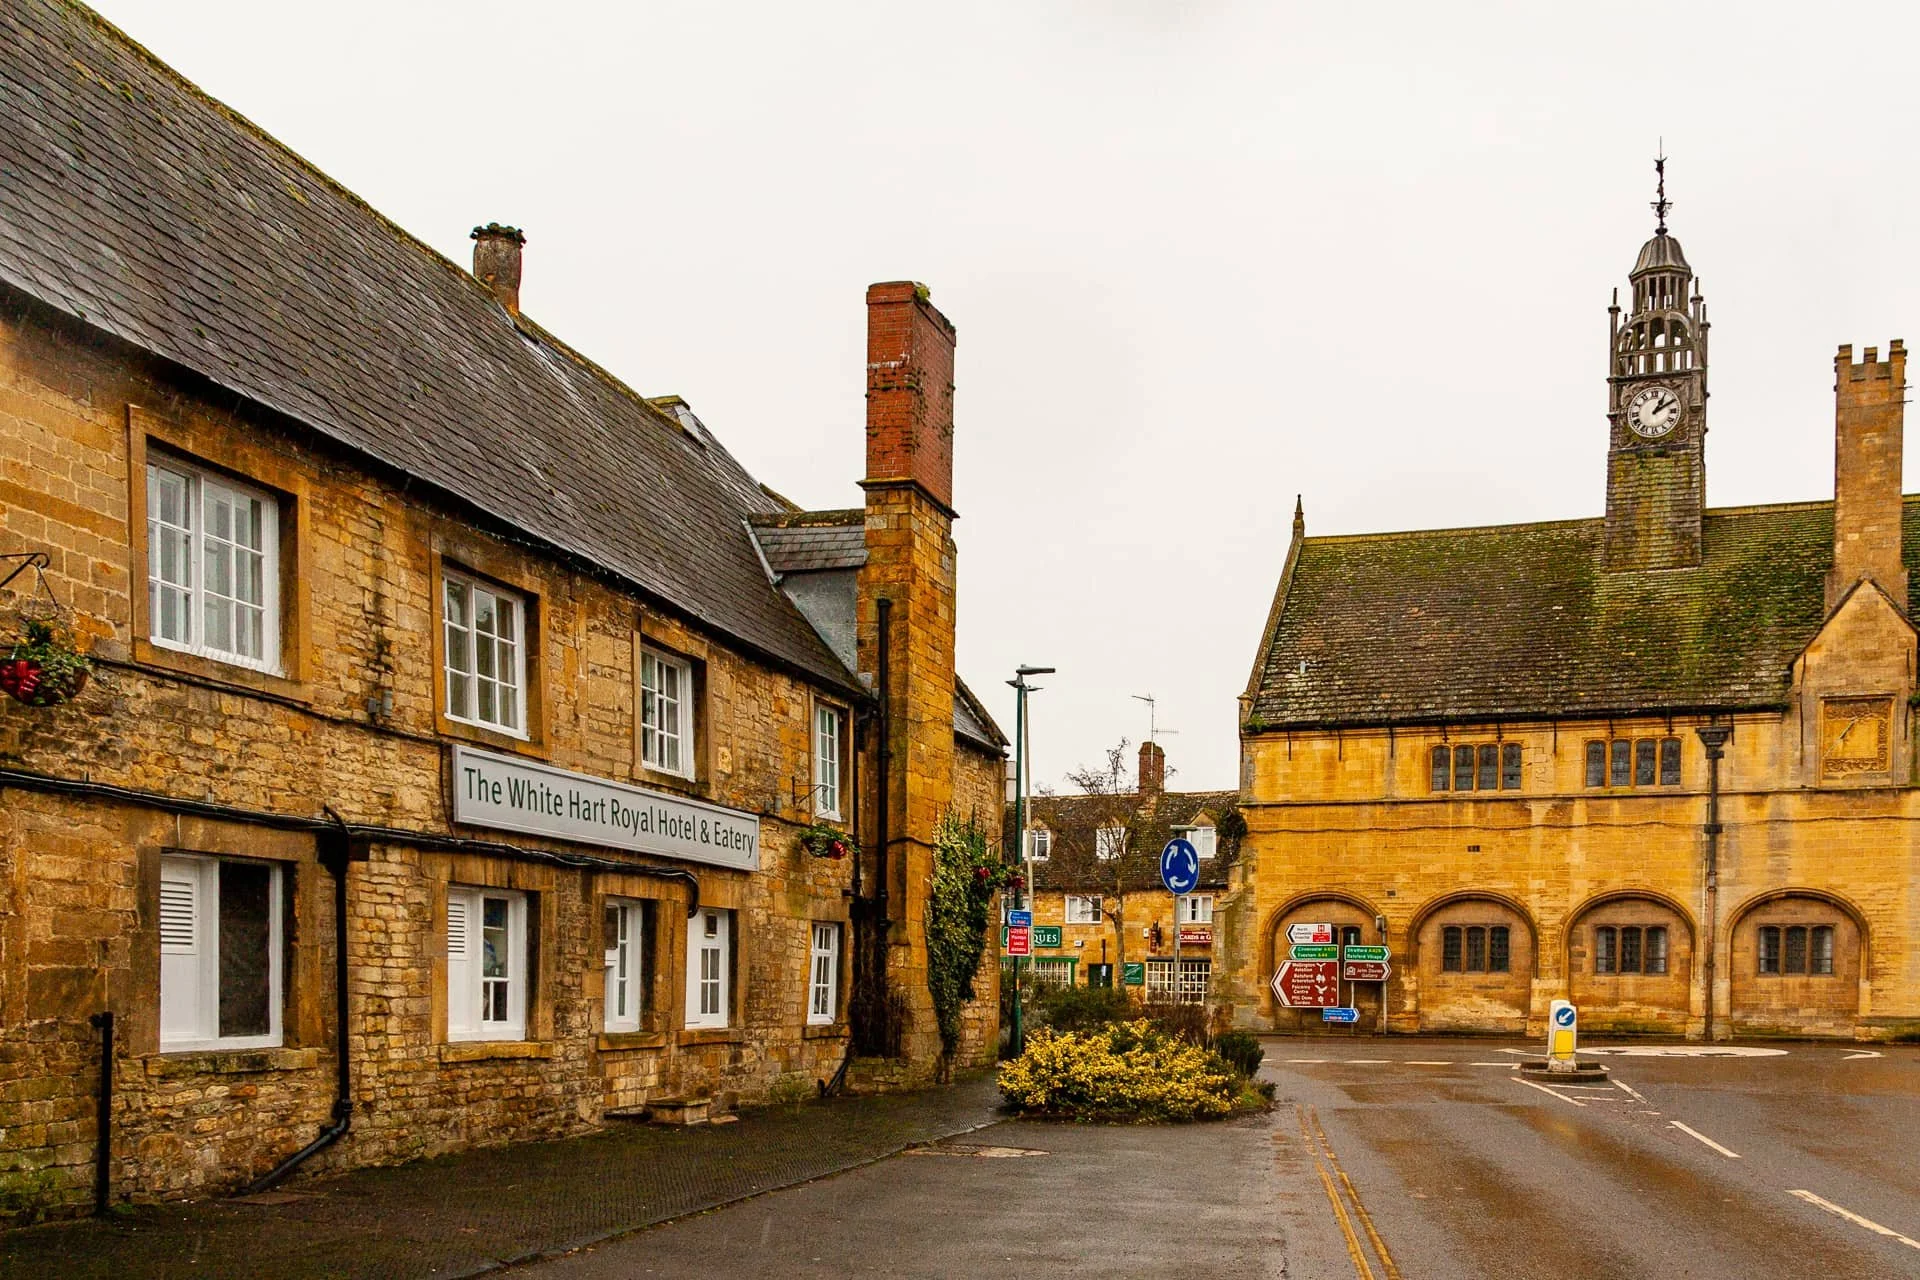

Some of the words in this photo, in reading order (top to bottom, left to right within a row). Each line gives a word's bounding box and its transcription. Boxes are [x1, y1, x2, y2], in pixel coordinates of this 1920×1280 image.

[464, 767, 502, 805] The
[507, 777, 563, 817] White
[569, 789, 606, 825] Hart
[611, 798, 655, 837] Royal
[658, 808, 697, 842] Hotel
[700, 819, 711, 844] &
[714, 821, 754, 858] Eatery
